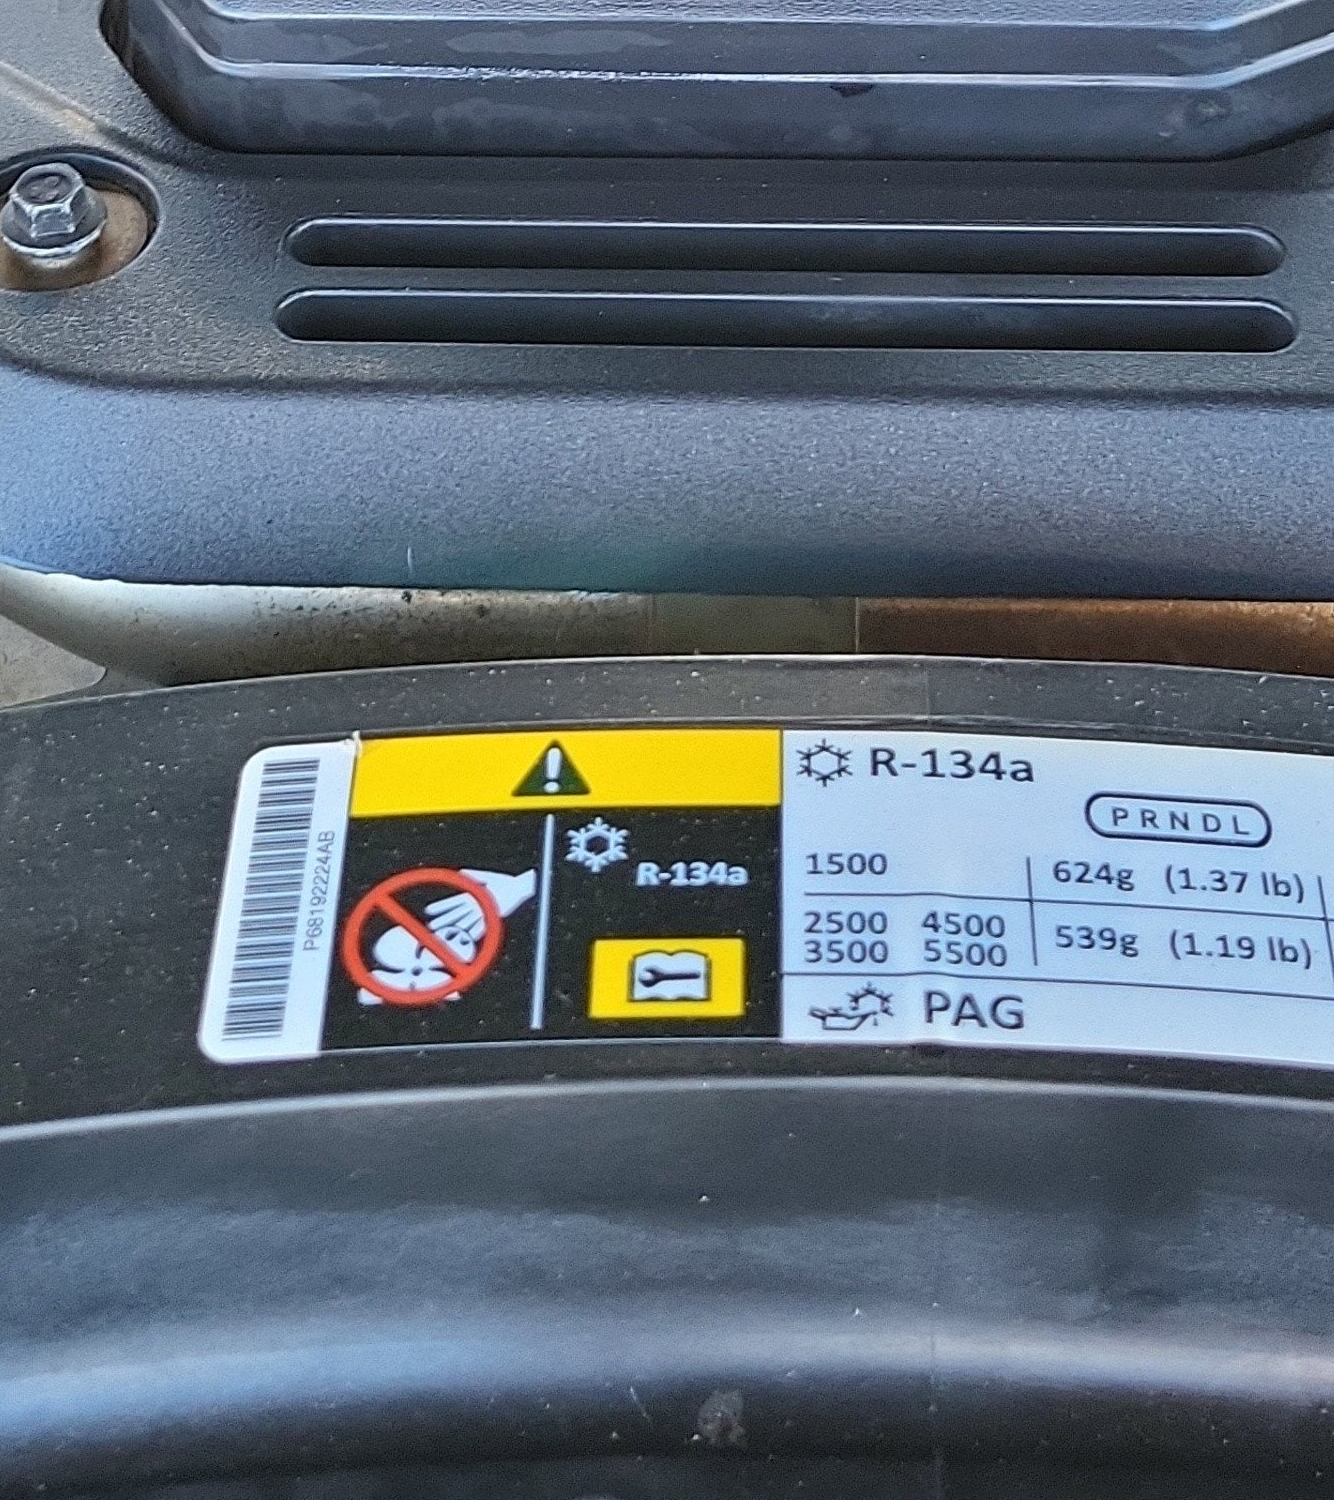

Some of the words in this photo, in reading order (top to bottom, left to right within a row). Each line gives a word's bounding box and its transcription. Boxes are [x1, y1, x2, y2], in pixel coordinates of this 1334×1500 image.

[869, 747, 1035, 783] R-134a
[636, 861, 750, 887] R-134a
[804, 852, 888, 876] 1500
[303, 830, 336, 951] P68192224AB
[1052, 860, 1135, 892] 624g
[1165, 864, 1249, 895] (1.37
[1260, 870, 1305, 904] lb)
[803, 911, 889, 935] 2500
[921, 911, 1006, 938] 4500
[803, 939, 889, 964] 3500
[922, 939, 1008, 968] 5500
[1054, 925, 1140, 958] 539g
[1169, 929, 1256, 961] (1.19
[1266, 936, 1313, 970] lb)
[923, 989, 1025, 1030] PAG
